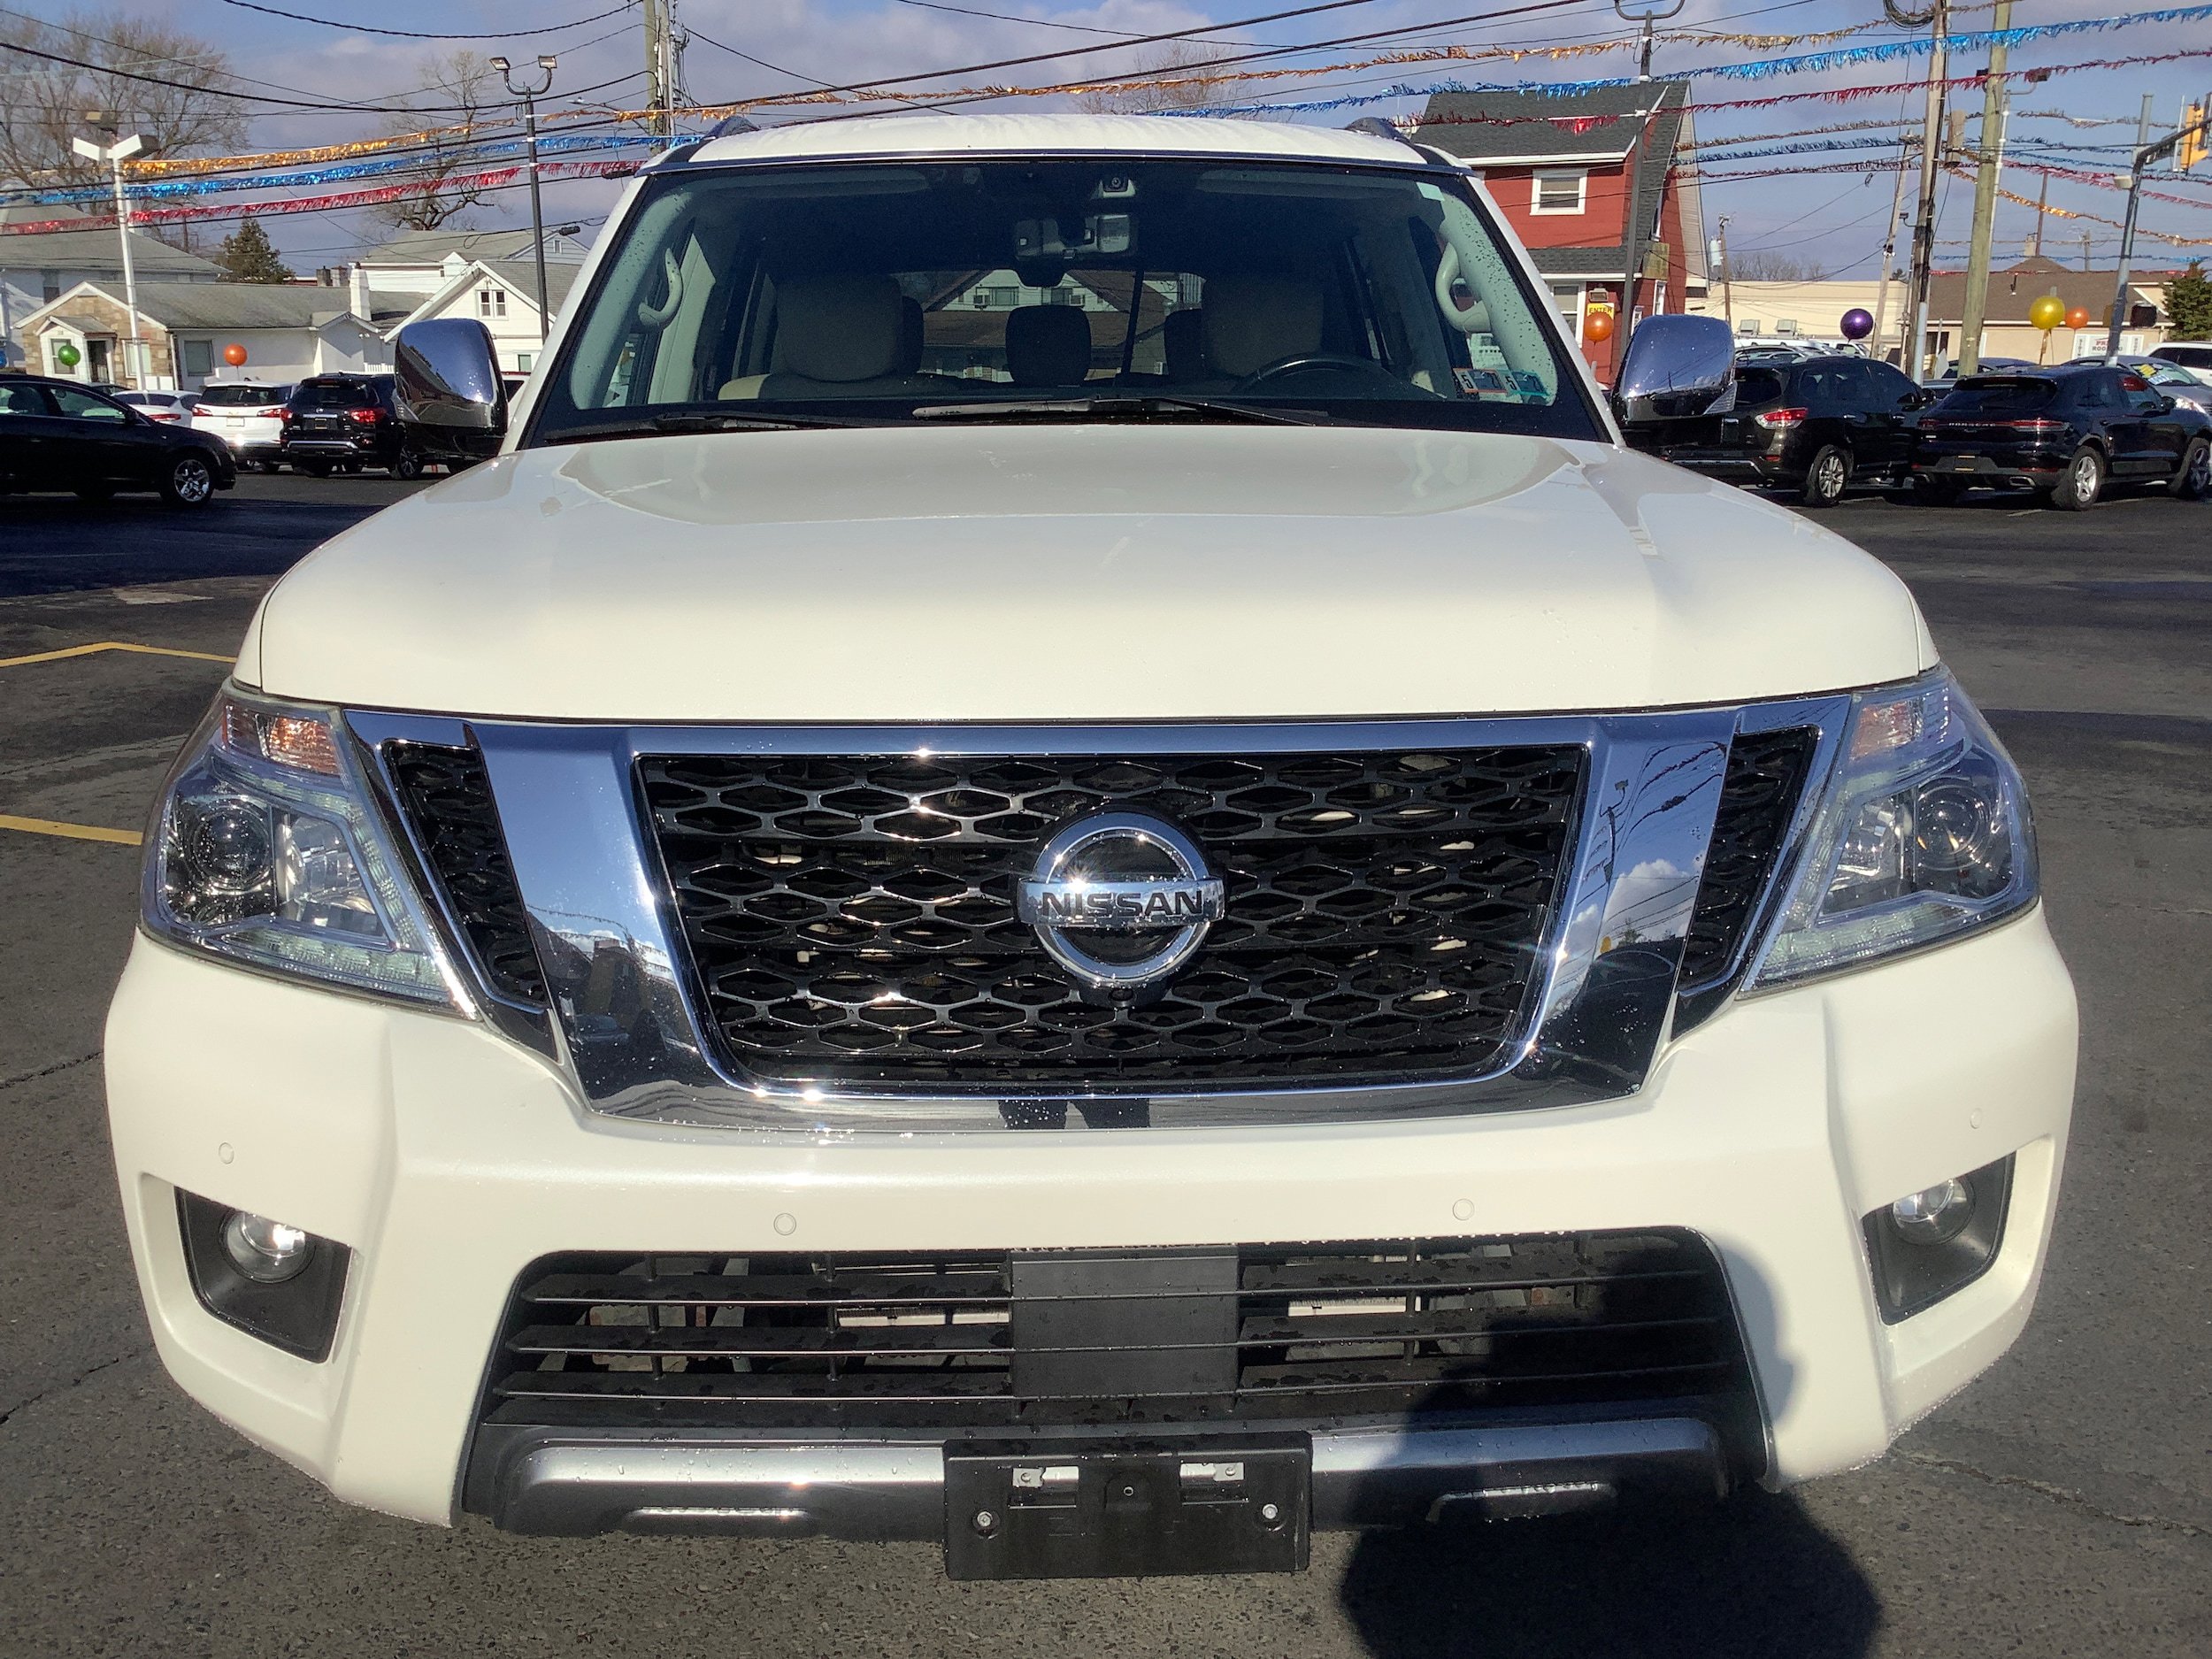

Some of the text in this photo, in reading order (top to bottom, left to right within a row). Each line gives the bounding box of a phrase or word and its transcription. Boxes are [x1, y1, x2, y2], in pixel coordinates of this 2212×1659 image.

[1461, 374, 1473, 389] 5
[1505, 375, 1517, 390] 5
[1041, 890, 1204, 918] NISSAN
